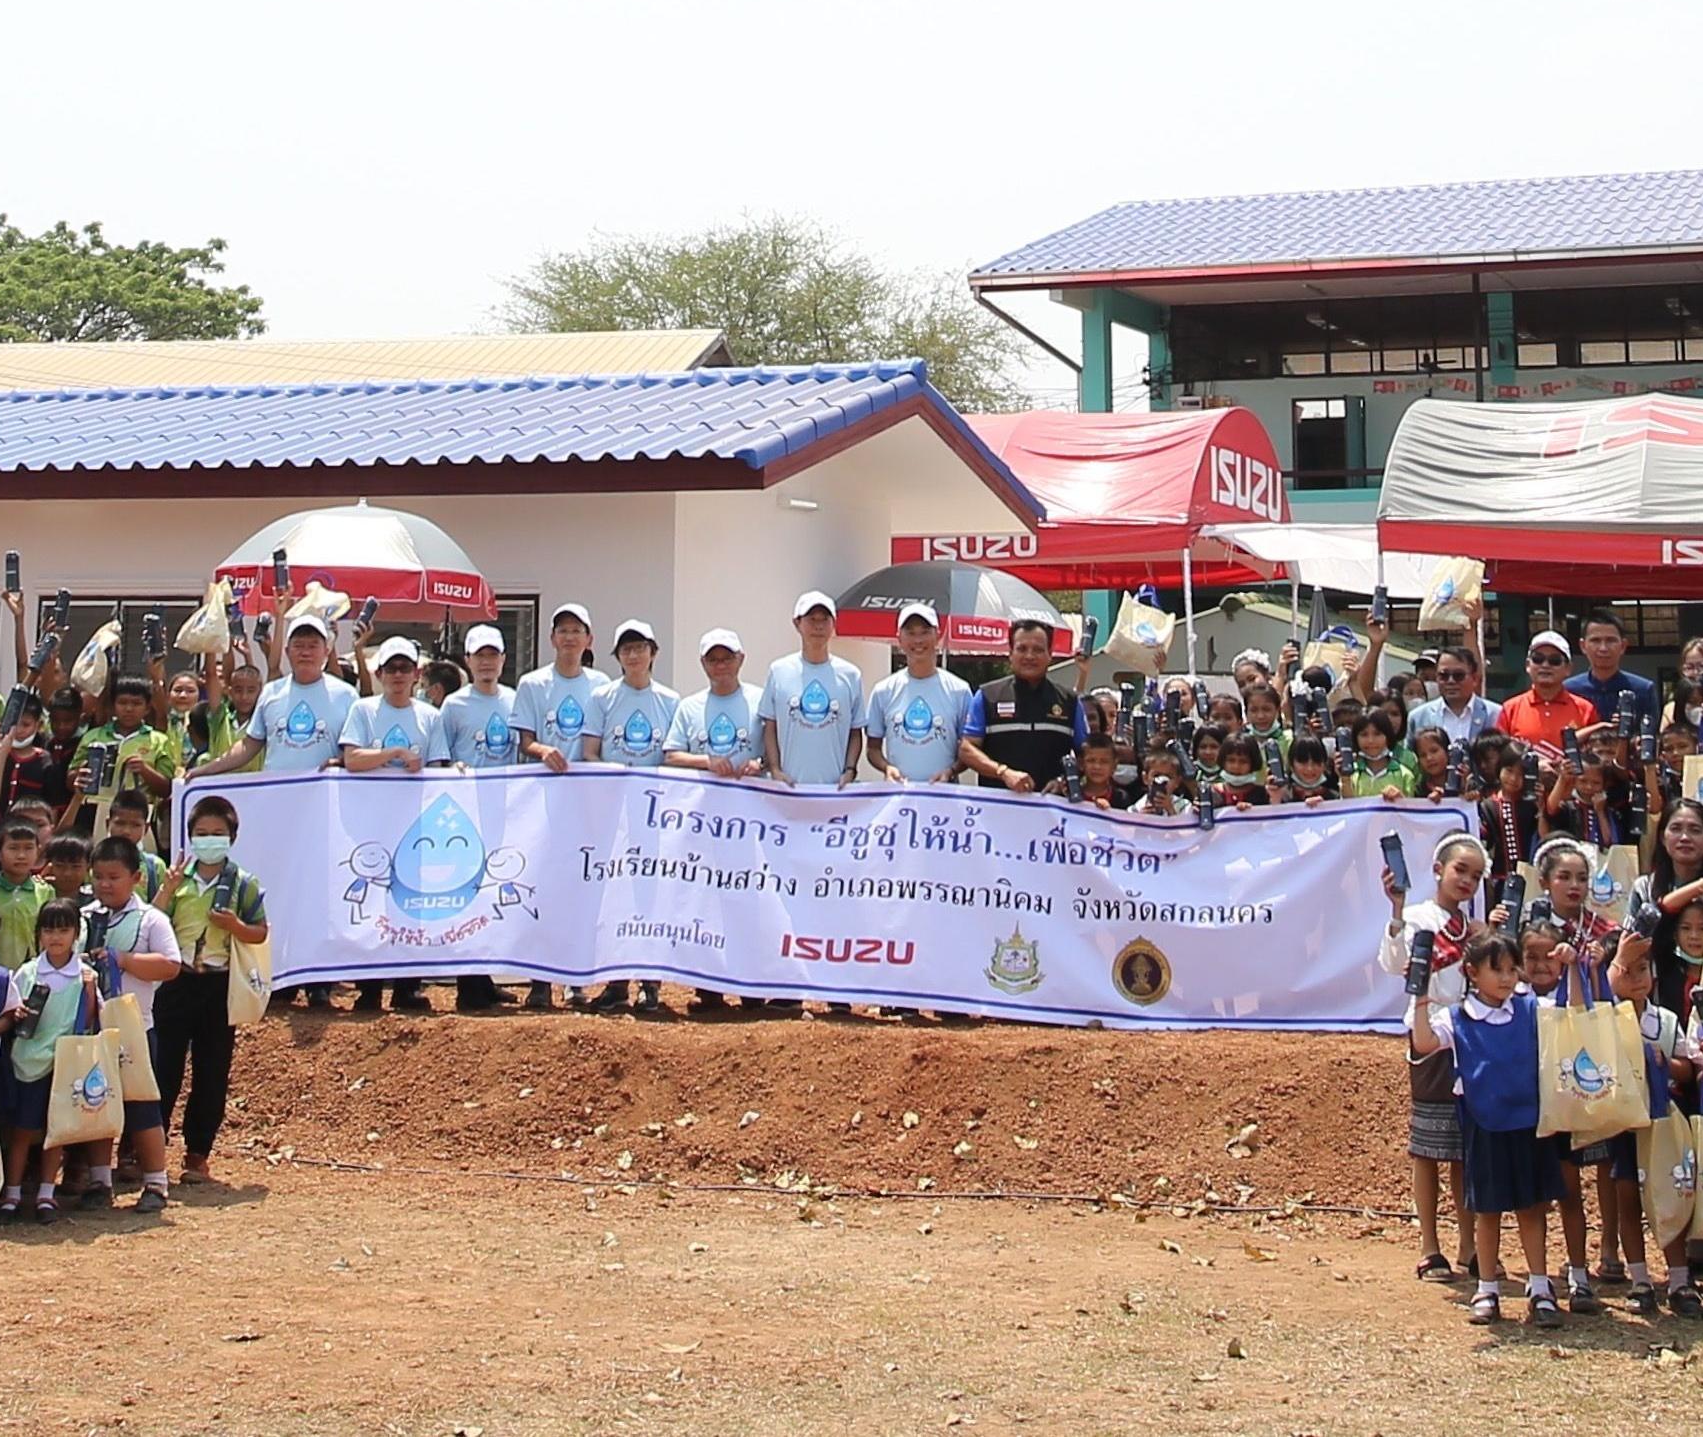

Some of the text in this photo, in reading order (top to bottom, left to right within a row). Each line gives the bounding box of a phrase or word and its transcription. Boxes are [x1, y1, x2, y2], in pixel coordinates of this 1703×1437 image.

[1210, 444, 1284, 523] ISUZU
[921, 535, 1038, 562] ISUZU
[433, 581, 473, 599] ISUZU
[958, 623, 1003, 638] ISUZU
[644, 790, 789, 847] โครงการ
[579, 846, 1273, 924] โรงเรียนบ้านสว่าง อำเภอพรรณานิคม จังหวัดสกลนคร
[403, 896, 466, 910] ISUZU
[616, 916, 726, 952] สนับสนุนโดย
[781, 934, 915, 965] ISUZU
